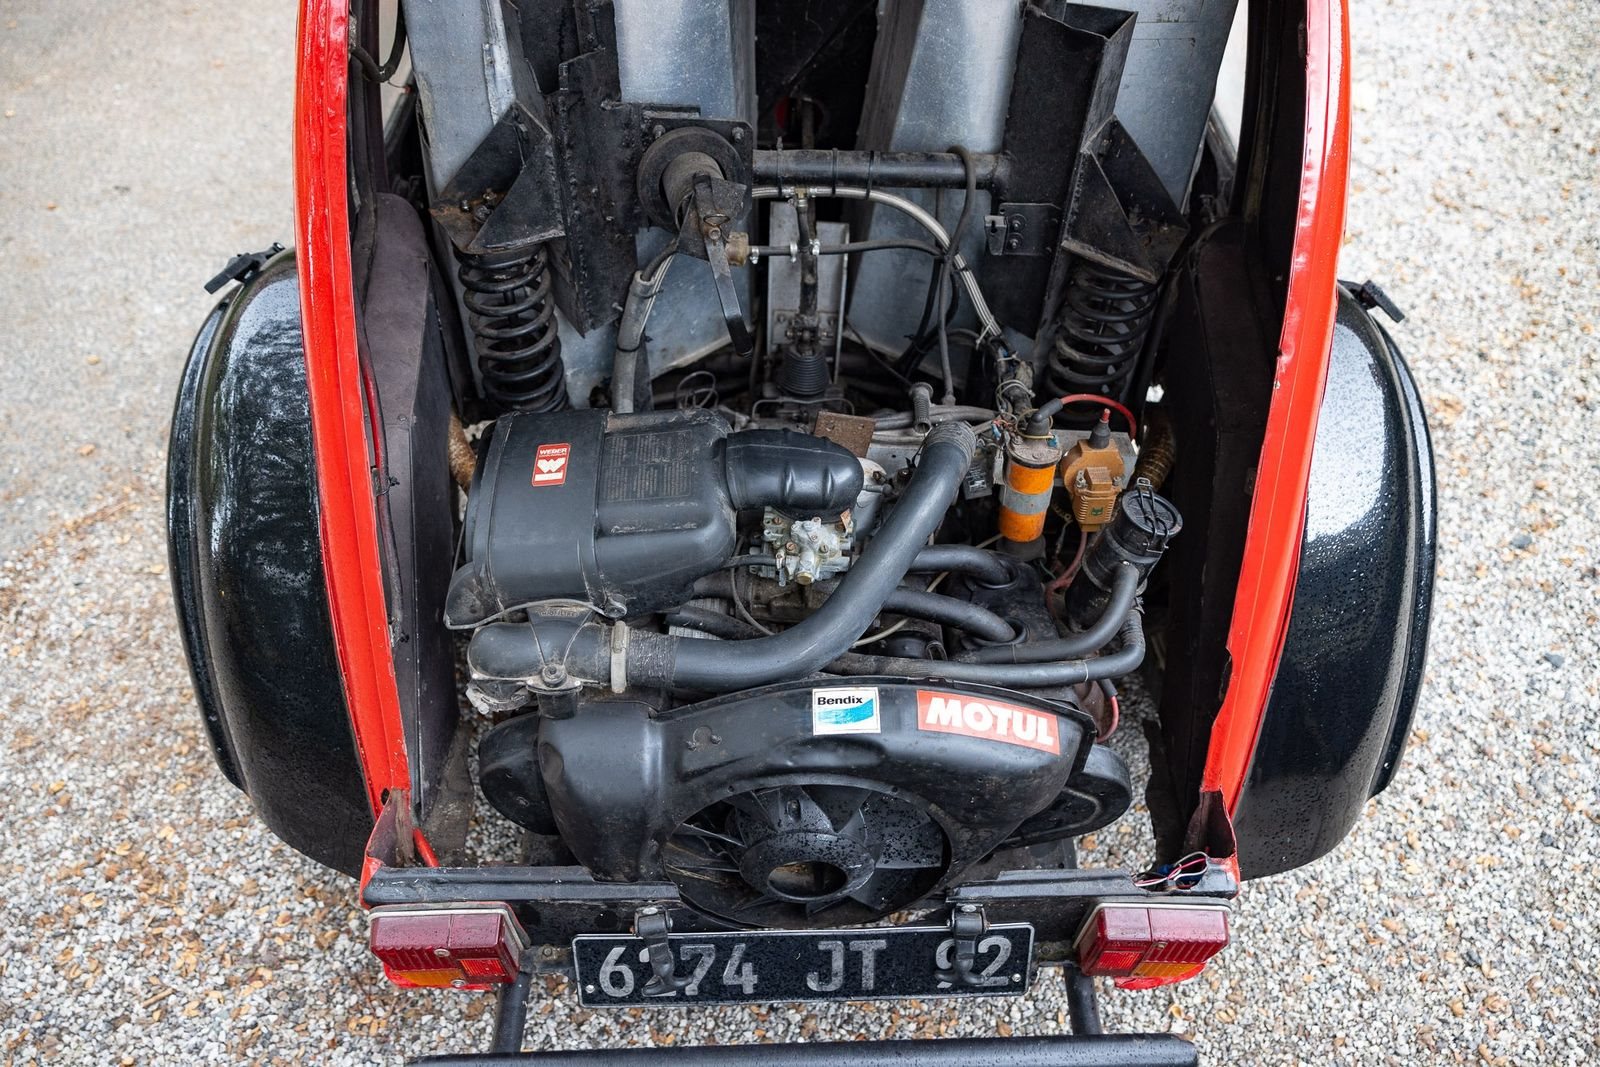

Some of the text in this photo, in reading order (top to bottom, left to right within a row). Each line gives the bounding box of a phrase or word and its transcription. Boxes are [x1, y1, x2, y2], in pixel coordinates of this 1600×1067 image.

[817, 695, 863, 706] Bendix
[925, 696, 1055, 746] MOTUL
[599, 942, 758, 998] 674
[806, 939, 887, 992] JT
